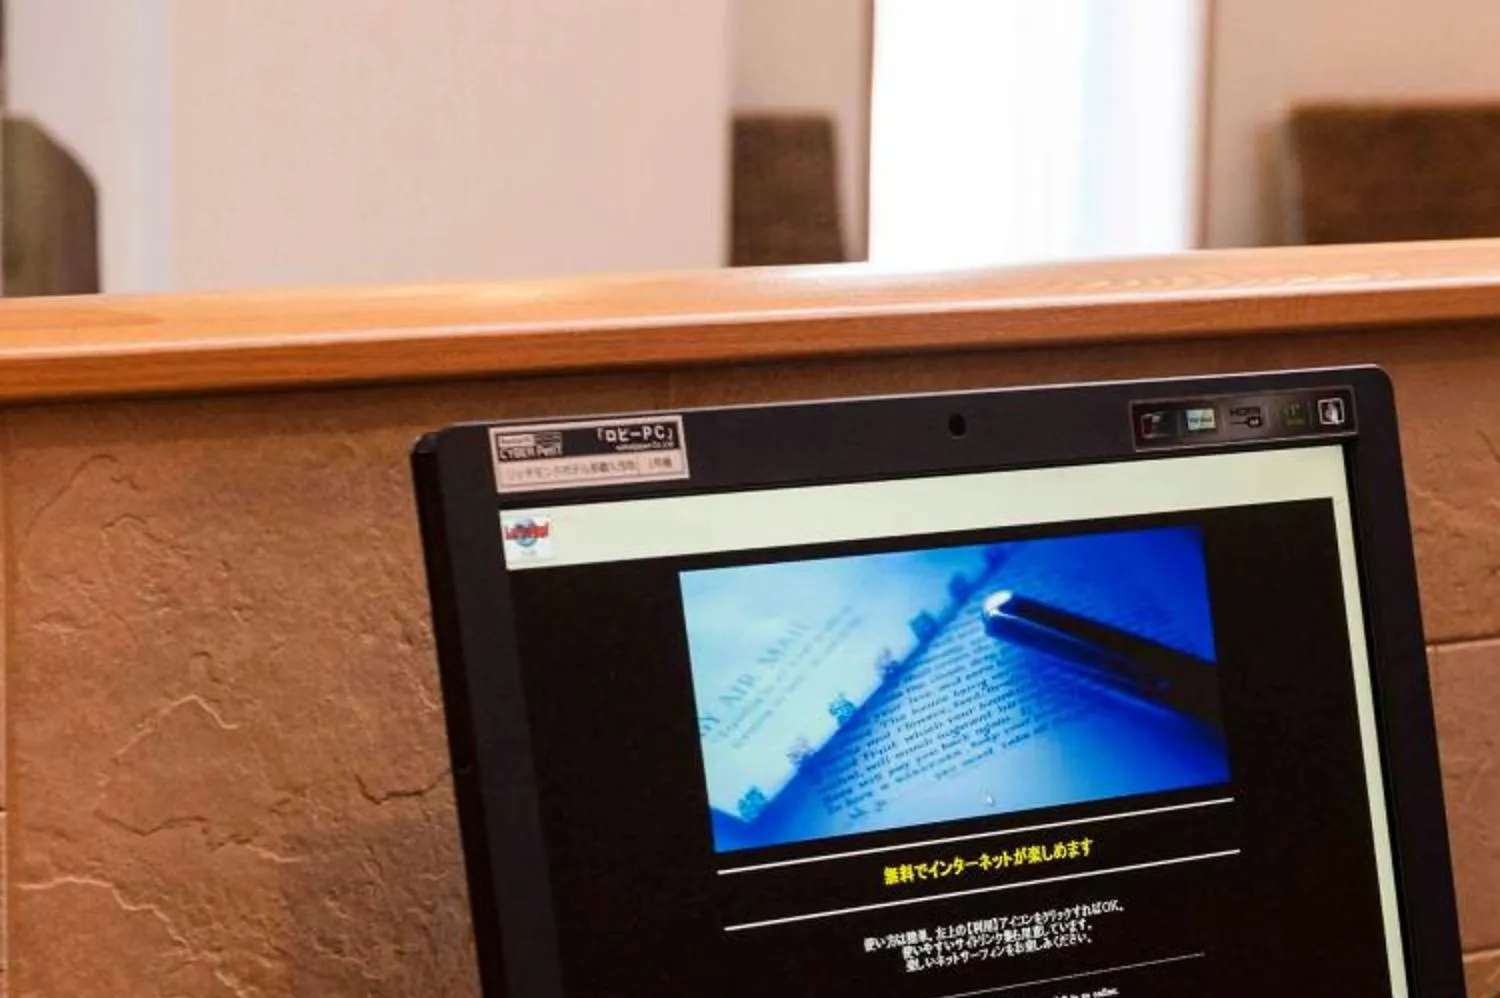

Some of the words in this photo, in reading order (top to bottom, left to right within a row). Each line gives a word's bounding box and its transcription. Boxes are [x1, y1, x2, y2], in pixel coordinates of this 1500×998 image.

[883, 837, 1094, 886] 無料でインターネットが楽しめます
